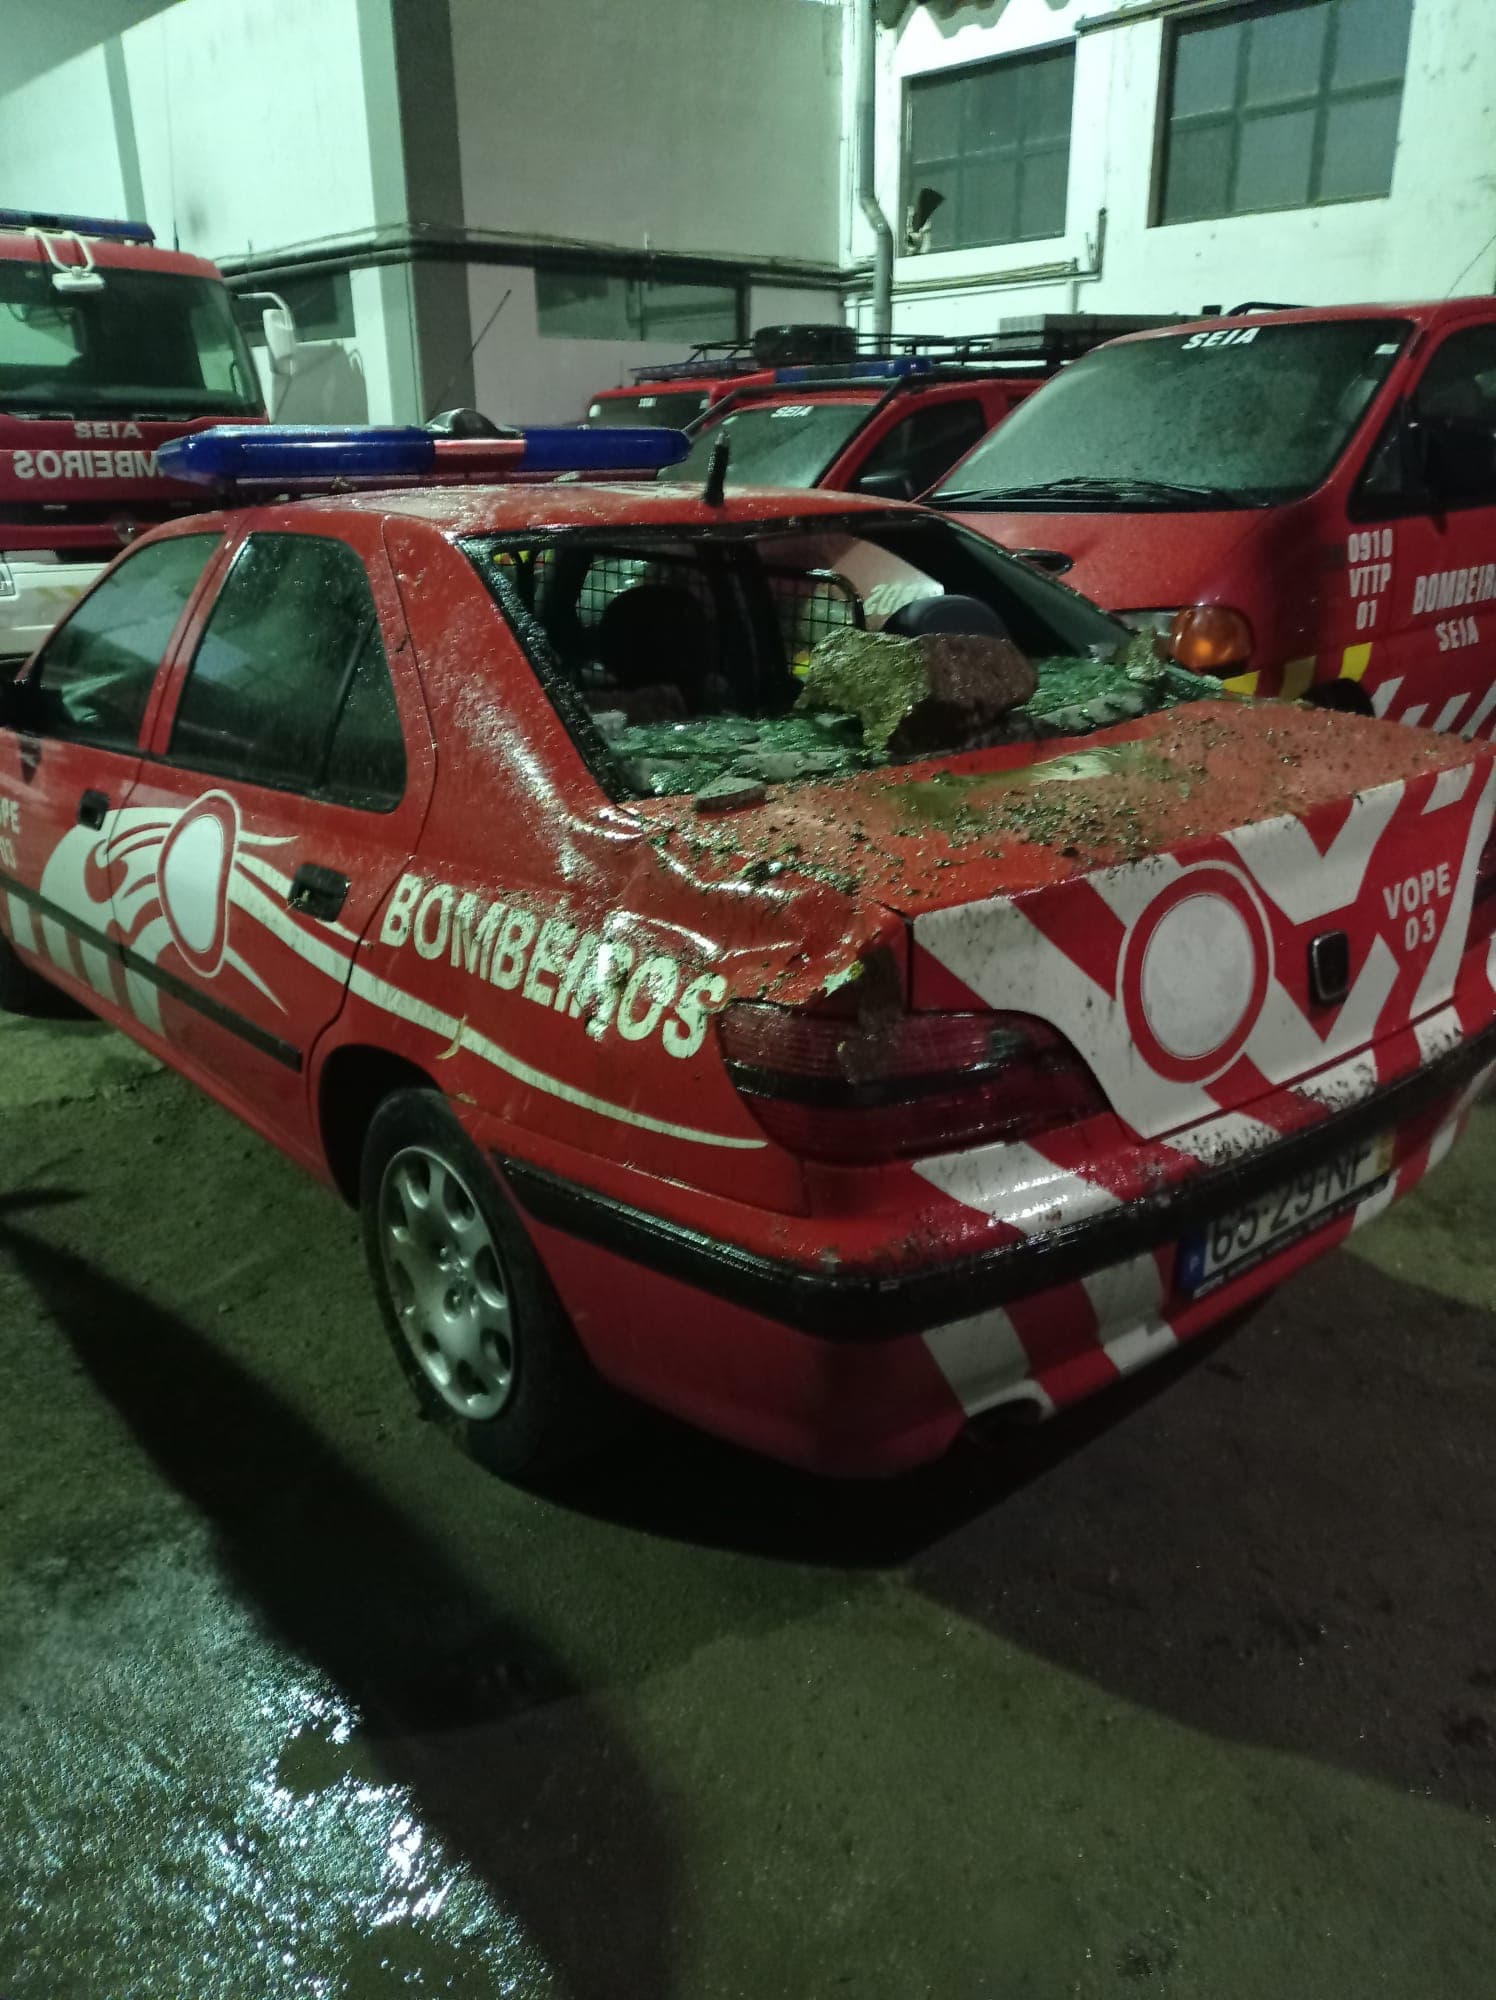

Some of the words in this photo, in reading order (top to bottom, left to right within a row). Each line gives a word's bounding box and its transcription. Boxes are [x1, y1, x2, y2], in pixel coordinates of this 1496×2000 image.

[1180, 326, 1261, 350] SEIA
[770, 405, 814, 418] SEIA
[1348, 528, 1393, 563] 0910
[1348, 563, 1392, 598] VTTP
[1355, 599, 1377, 630] 01
[1434, 615, 1480, 652] SEIA
[1382, 862, 1452, 920] VOPE
[1404, 908, 1436, 953] 03
[380, 873, 728, 1059] BOMBEIROS
